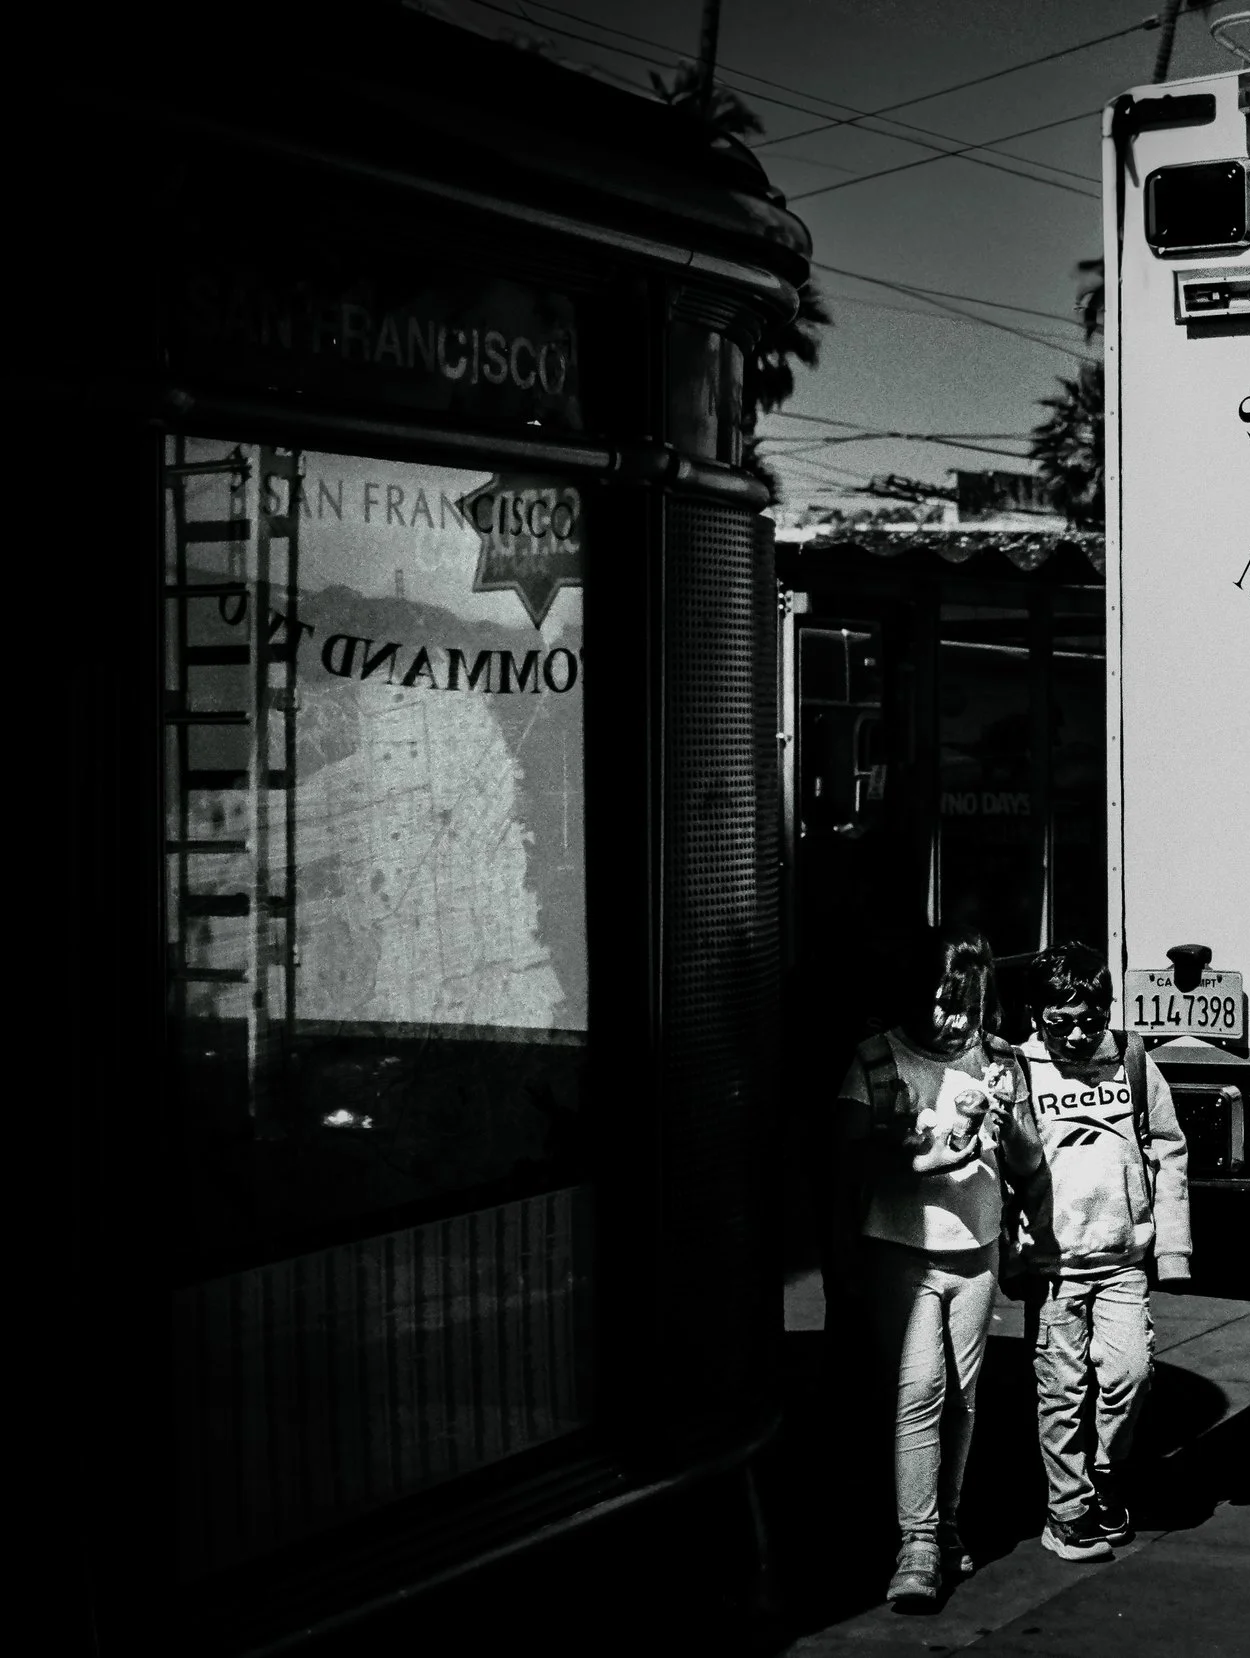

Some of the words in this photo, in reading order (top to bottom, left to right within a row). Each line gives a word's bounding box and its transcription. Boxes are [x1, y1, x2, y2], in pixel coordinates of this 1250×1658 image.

[313, 302, 569, 396] FRANCISCO
[364, 482, 577, 541] FRANCISCO
[981, 791, 1032, 817] DAYS
[1156, 977, 1173, 987] CA
[1134, 994, 1236, 1028] 1147398
[1038, 1086, 1131, 1115] Reebo
